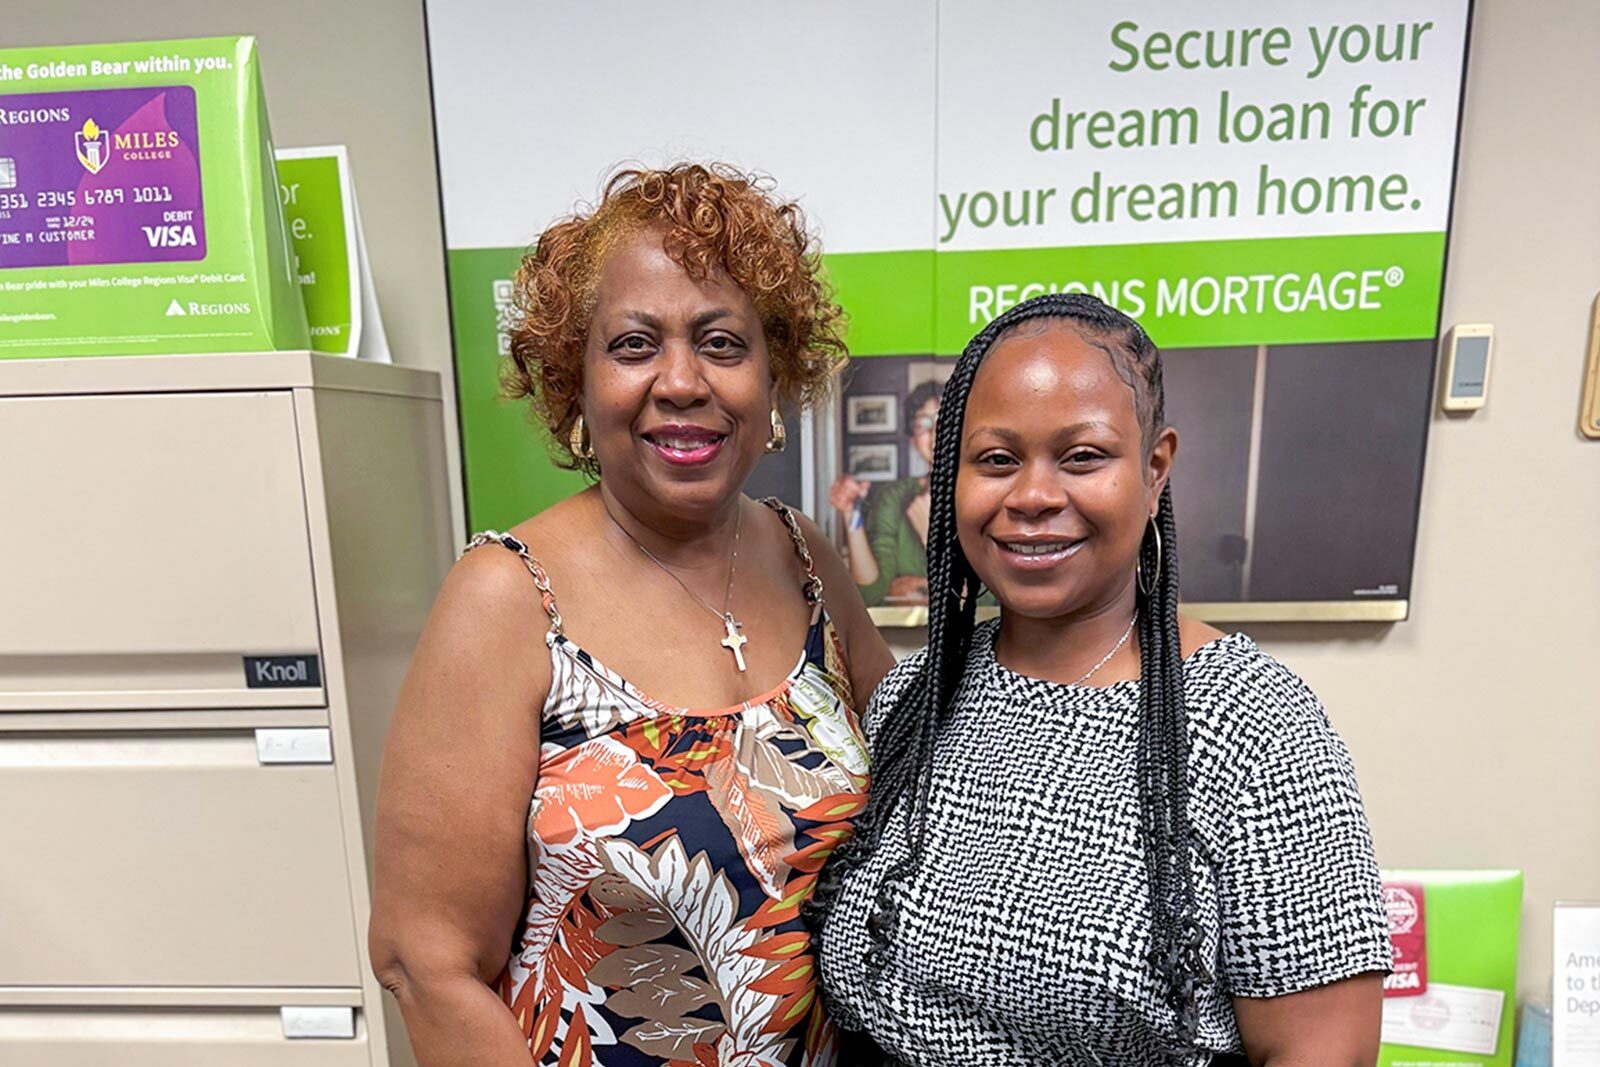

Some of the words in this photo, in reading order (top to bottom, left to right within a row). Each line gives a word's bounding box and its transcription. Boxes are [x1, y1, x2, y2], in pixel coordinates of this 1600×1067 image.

[1108, 21, 1292, 72] Secure
[1307, 21, 1433, 78] your
[0, 63, 23, 80] he
[26, 61, 87, 79] Golden
[91, 60, 131, 76] Bear
[134, 54, 191, 73] within
[194, 57, 233, 74] you.
[1030, 98, 1199, 152] dream
[1217, 91, 1331, 144] loan
[1349, 84, 1427, 138] for
[114, 131, 180, 150] MILES
[123, 151, 172, 161] COLLEGE
[37, 190, 76, 208] 2345
[84, 187, 124, 205] 6789
[133, 186, 172, 203] 1011
[938, 187, 1056, 243] your
[1071, 171, 1239, 223] dream
[1257, 165, 1422, 217] home.
[62, 215, 95, 228] 12/24
[163, 210, 193, 222] DEBIT
[0, 233, 21, 245] INE
[38, 229, 96, 242] CUSTOMER
[141, 225, 197, 248] VISA
[5, 282, 24, 291] Bear
[25, 280, 47, 292] pride
[48, 280, 68, 289] with
[68, 280, 88, 290] your
[88, 278, 110, 288] Miles
[111, 277, 142, 288] College
[143, 275, 177, 288] Regions
[200, 273, 223, 283] Debit
[224, 273, 247, 283] Card.
[1156, 265, 1405, 318] MORTGAGE®
[188, 302, 251, 315] REGIONS
[255, 660, 308, 682] Knoll
[1567, 975, 1584, 991] to
